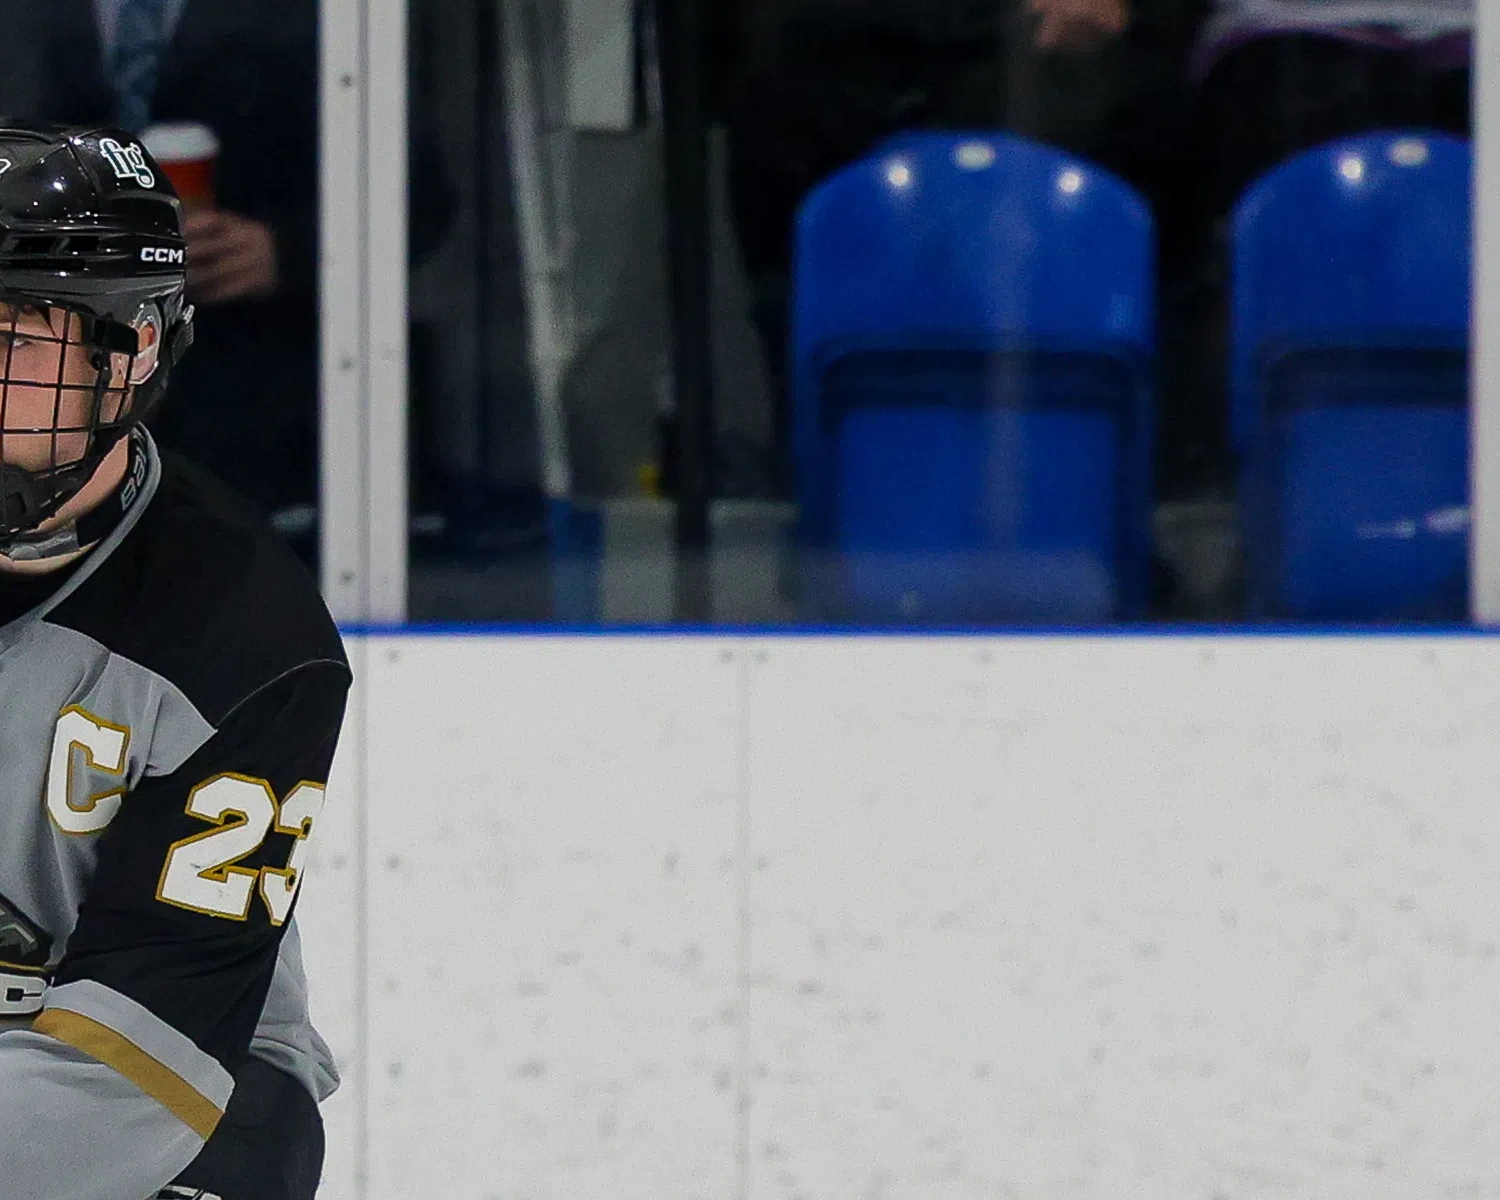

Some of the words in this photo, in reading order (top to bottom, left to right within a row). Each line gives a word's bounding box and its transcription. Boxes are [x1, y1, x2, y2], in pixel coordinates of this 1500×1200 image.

[140, 247, 184, 264] CCM
[45, 704, 131, 836] C
[156, 772, 327, 927] 23
